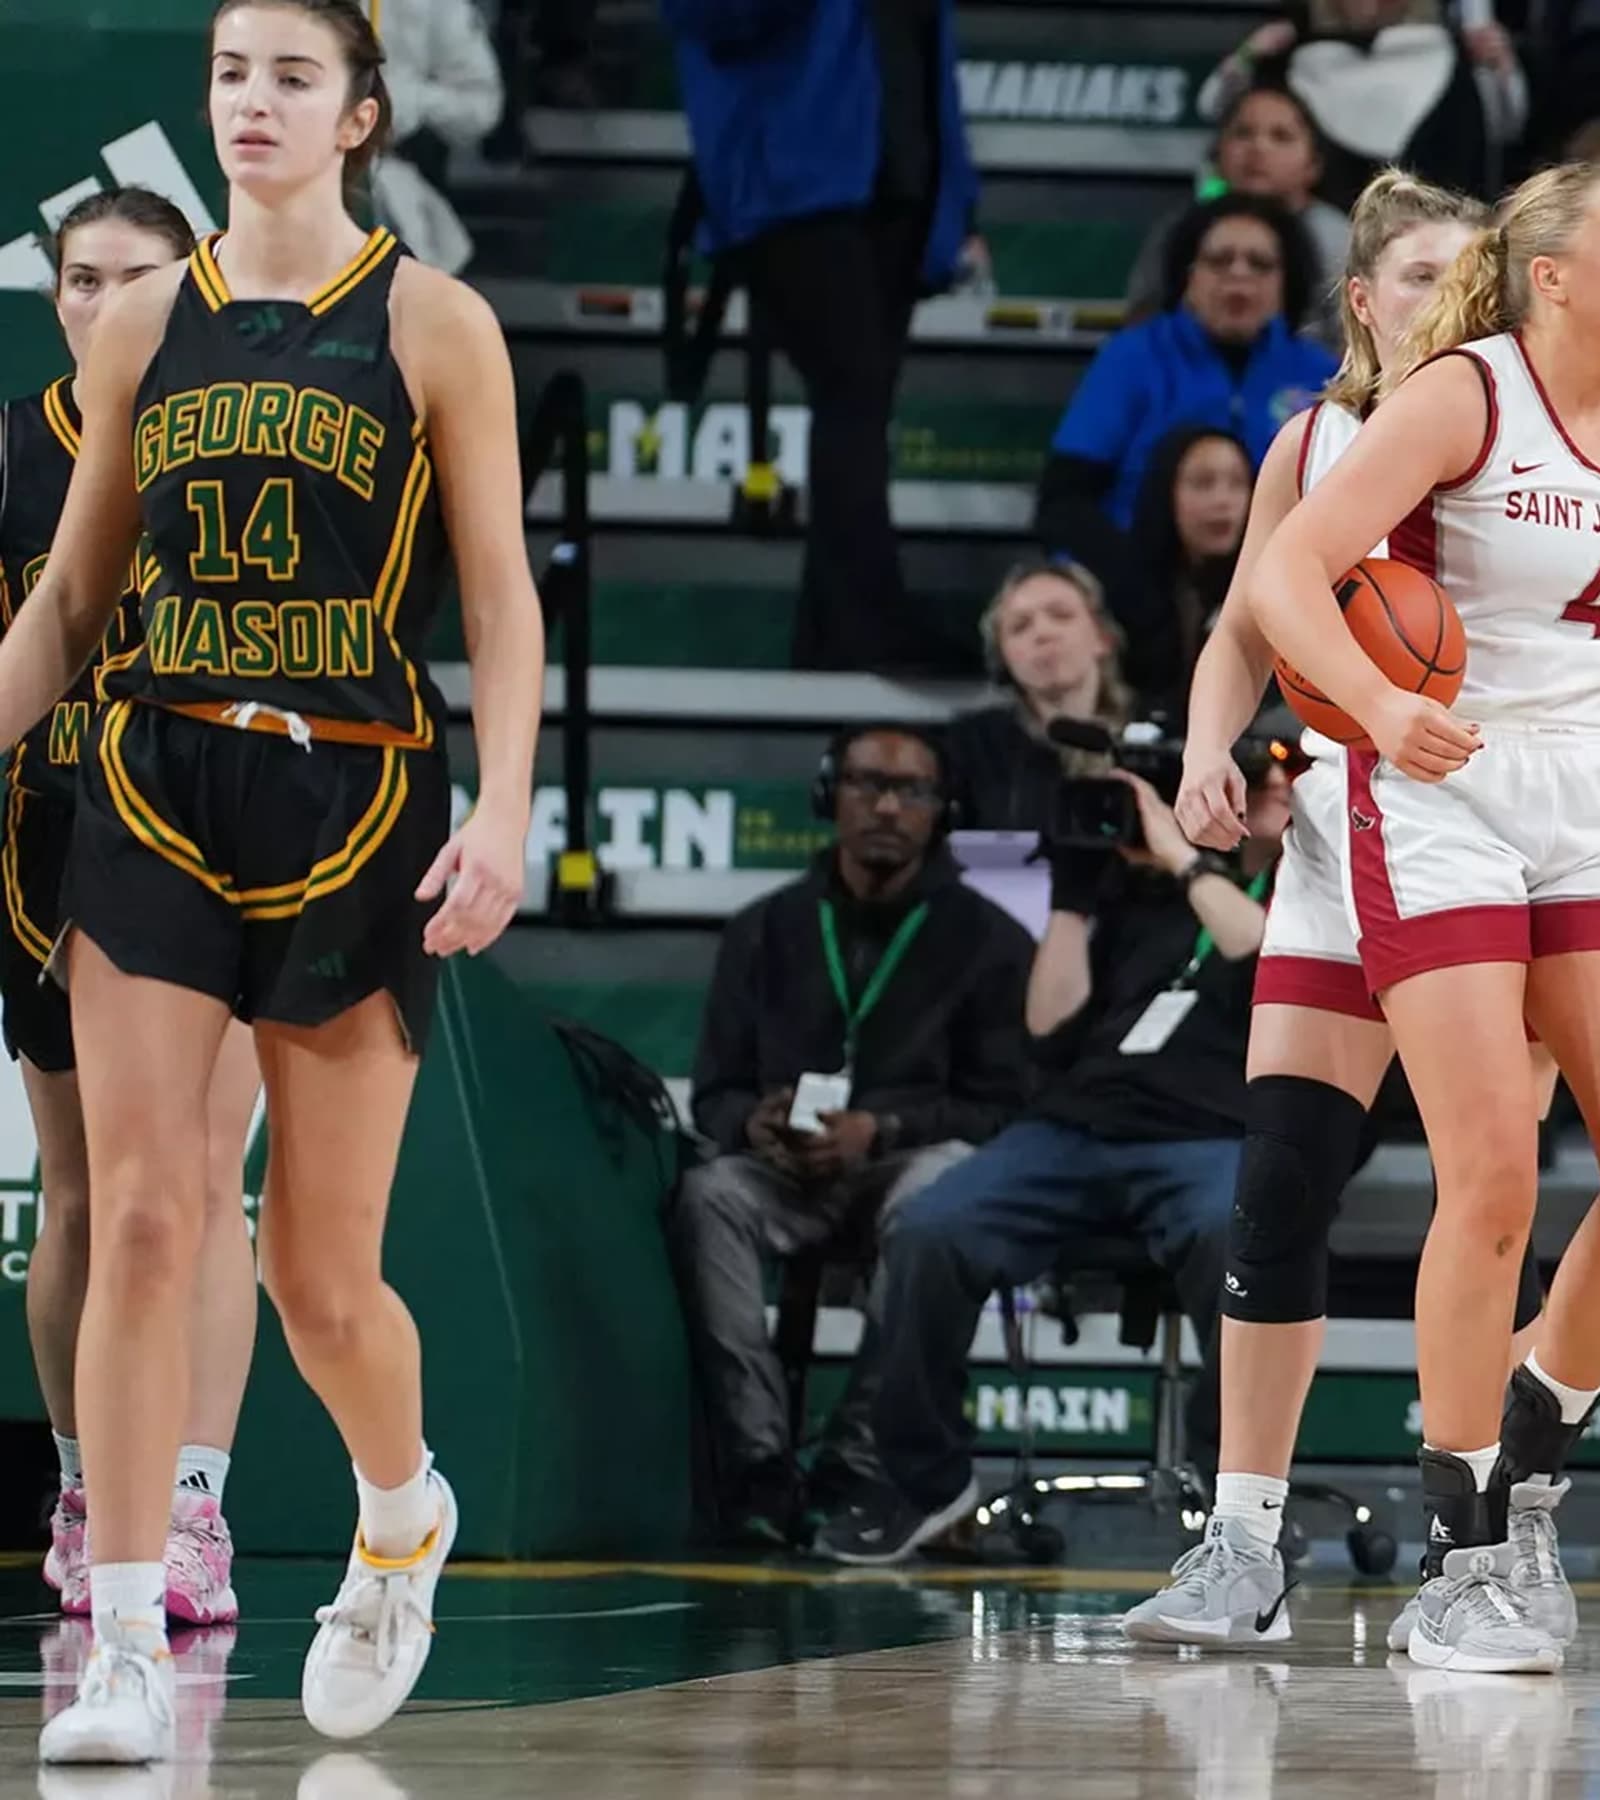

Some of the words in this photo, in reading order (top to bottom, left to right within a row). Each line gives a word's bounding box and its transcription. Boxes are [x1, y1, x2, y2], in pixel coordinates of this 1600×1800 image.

[133, 382, 386, 502] GEORGE
[186, 478, 300, 582] 14
[1505, 491, 1583, 531] SAINT
[150, 596, 374, 677] MASON
[977, 1385, 1128, 1434] MAIN
